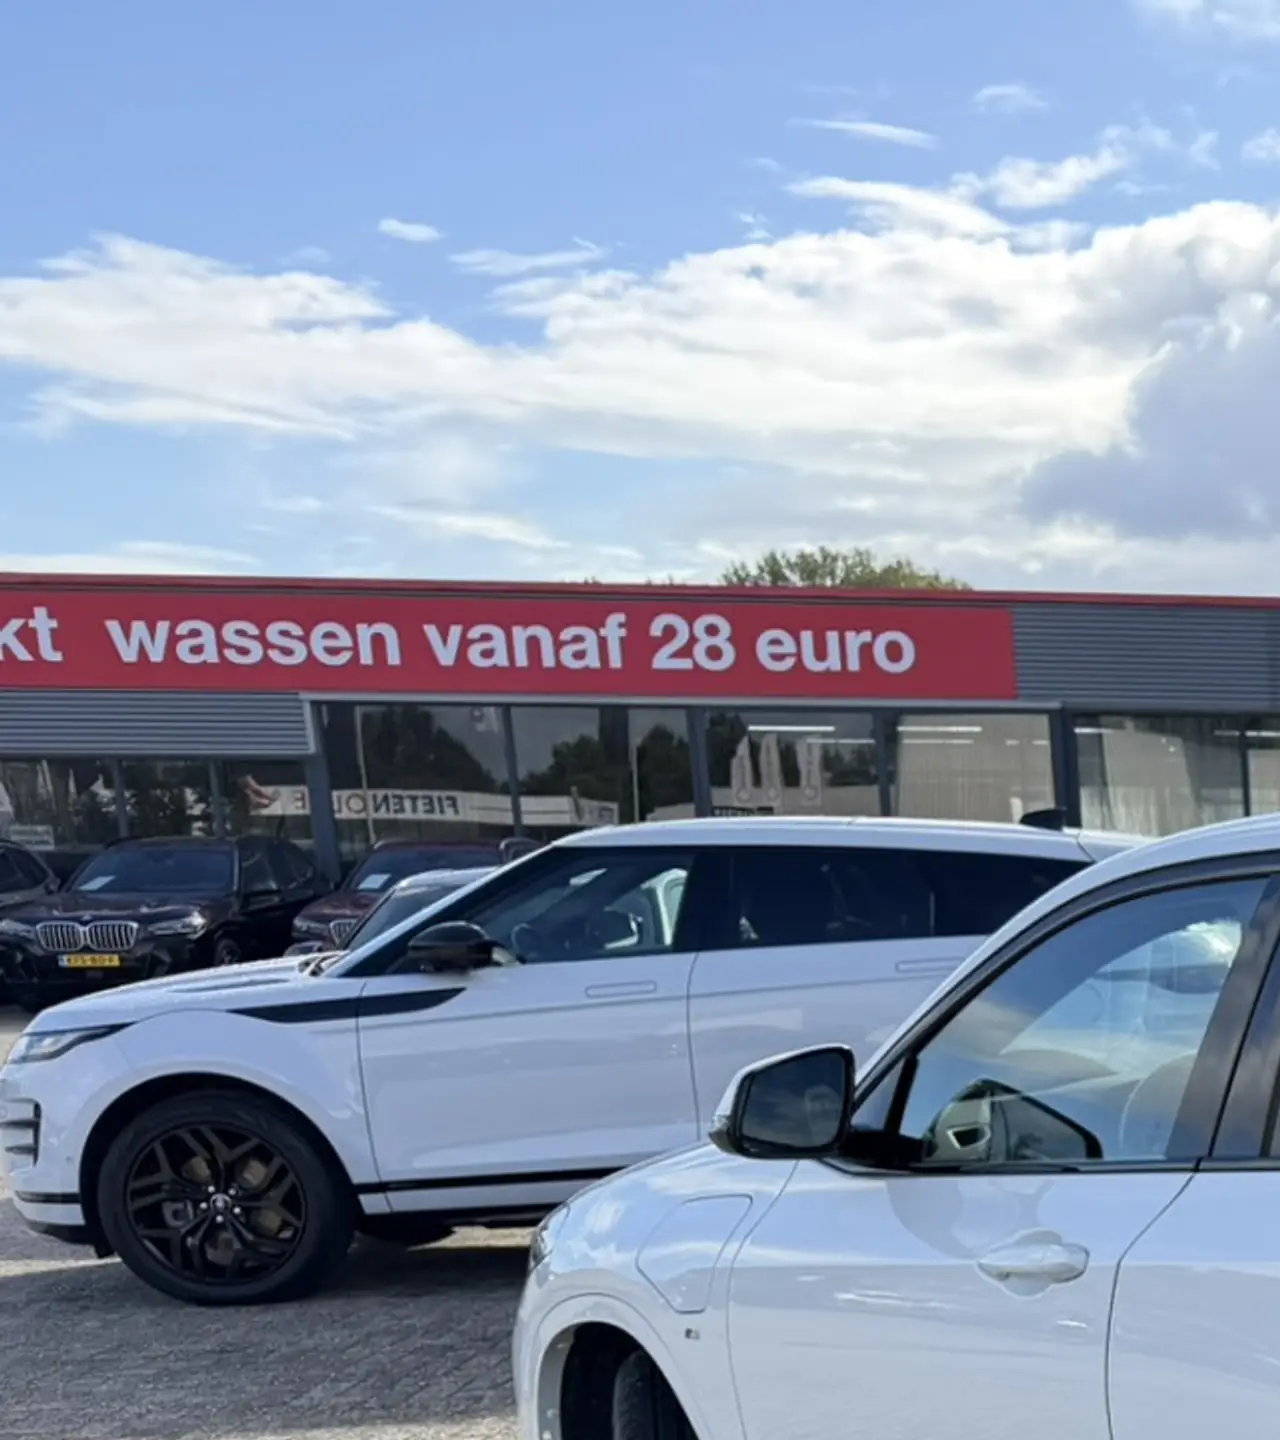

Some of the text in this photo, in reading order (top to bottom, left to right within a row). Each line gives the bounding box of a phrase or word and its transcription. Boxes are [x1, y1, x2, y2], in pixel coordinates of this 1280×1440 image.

[104, 618, 402, 666] wassen
[423, 613, 627, 669] vanaf
[649, 613, 736, 671] 28
[755, 628, 916, 674] euro
